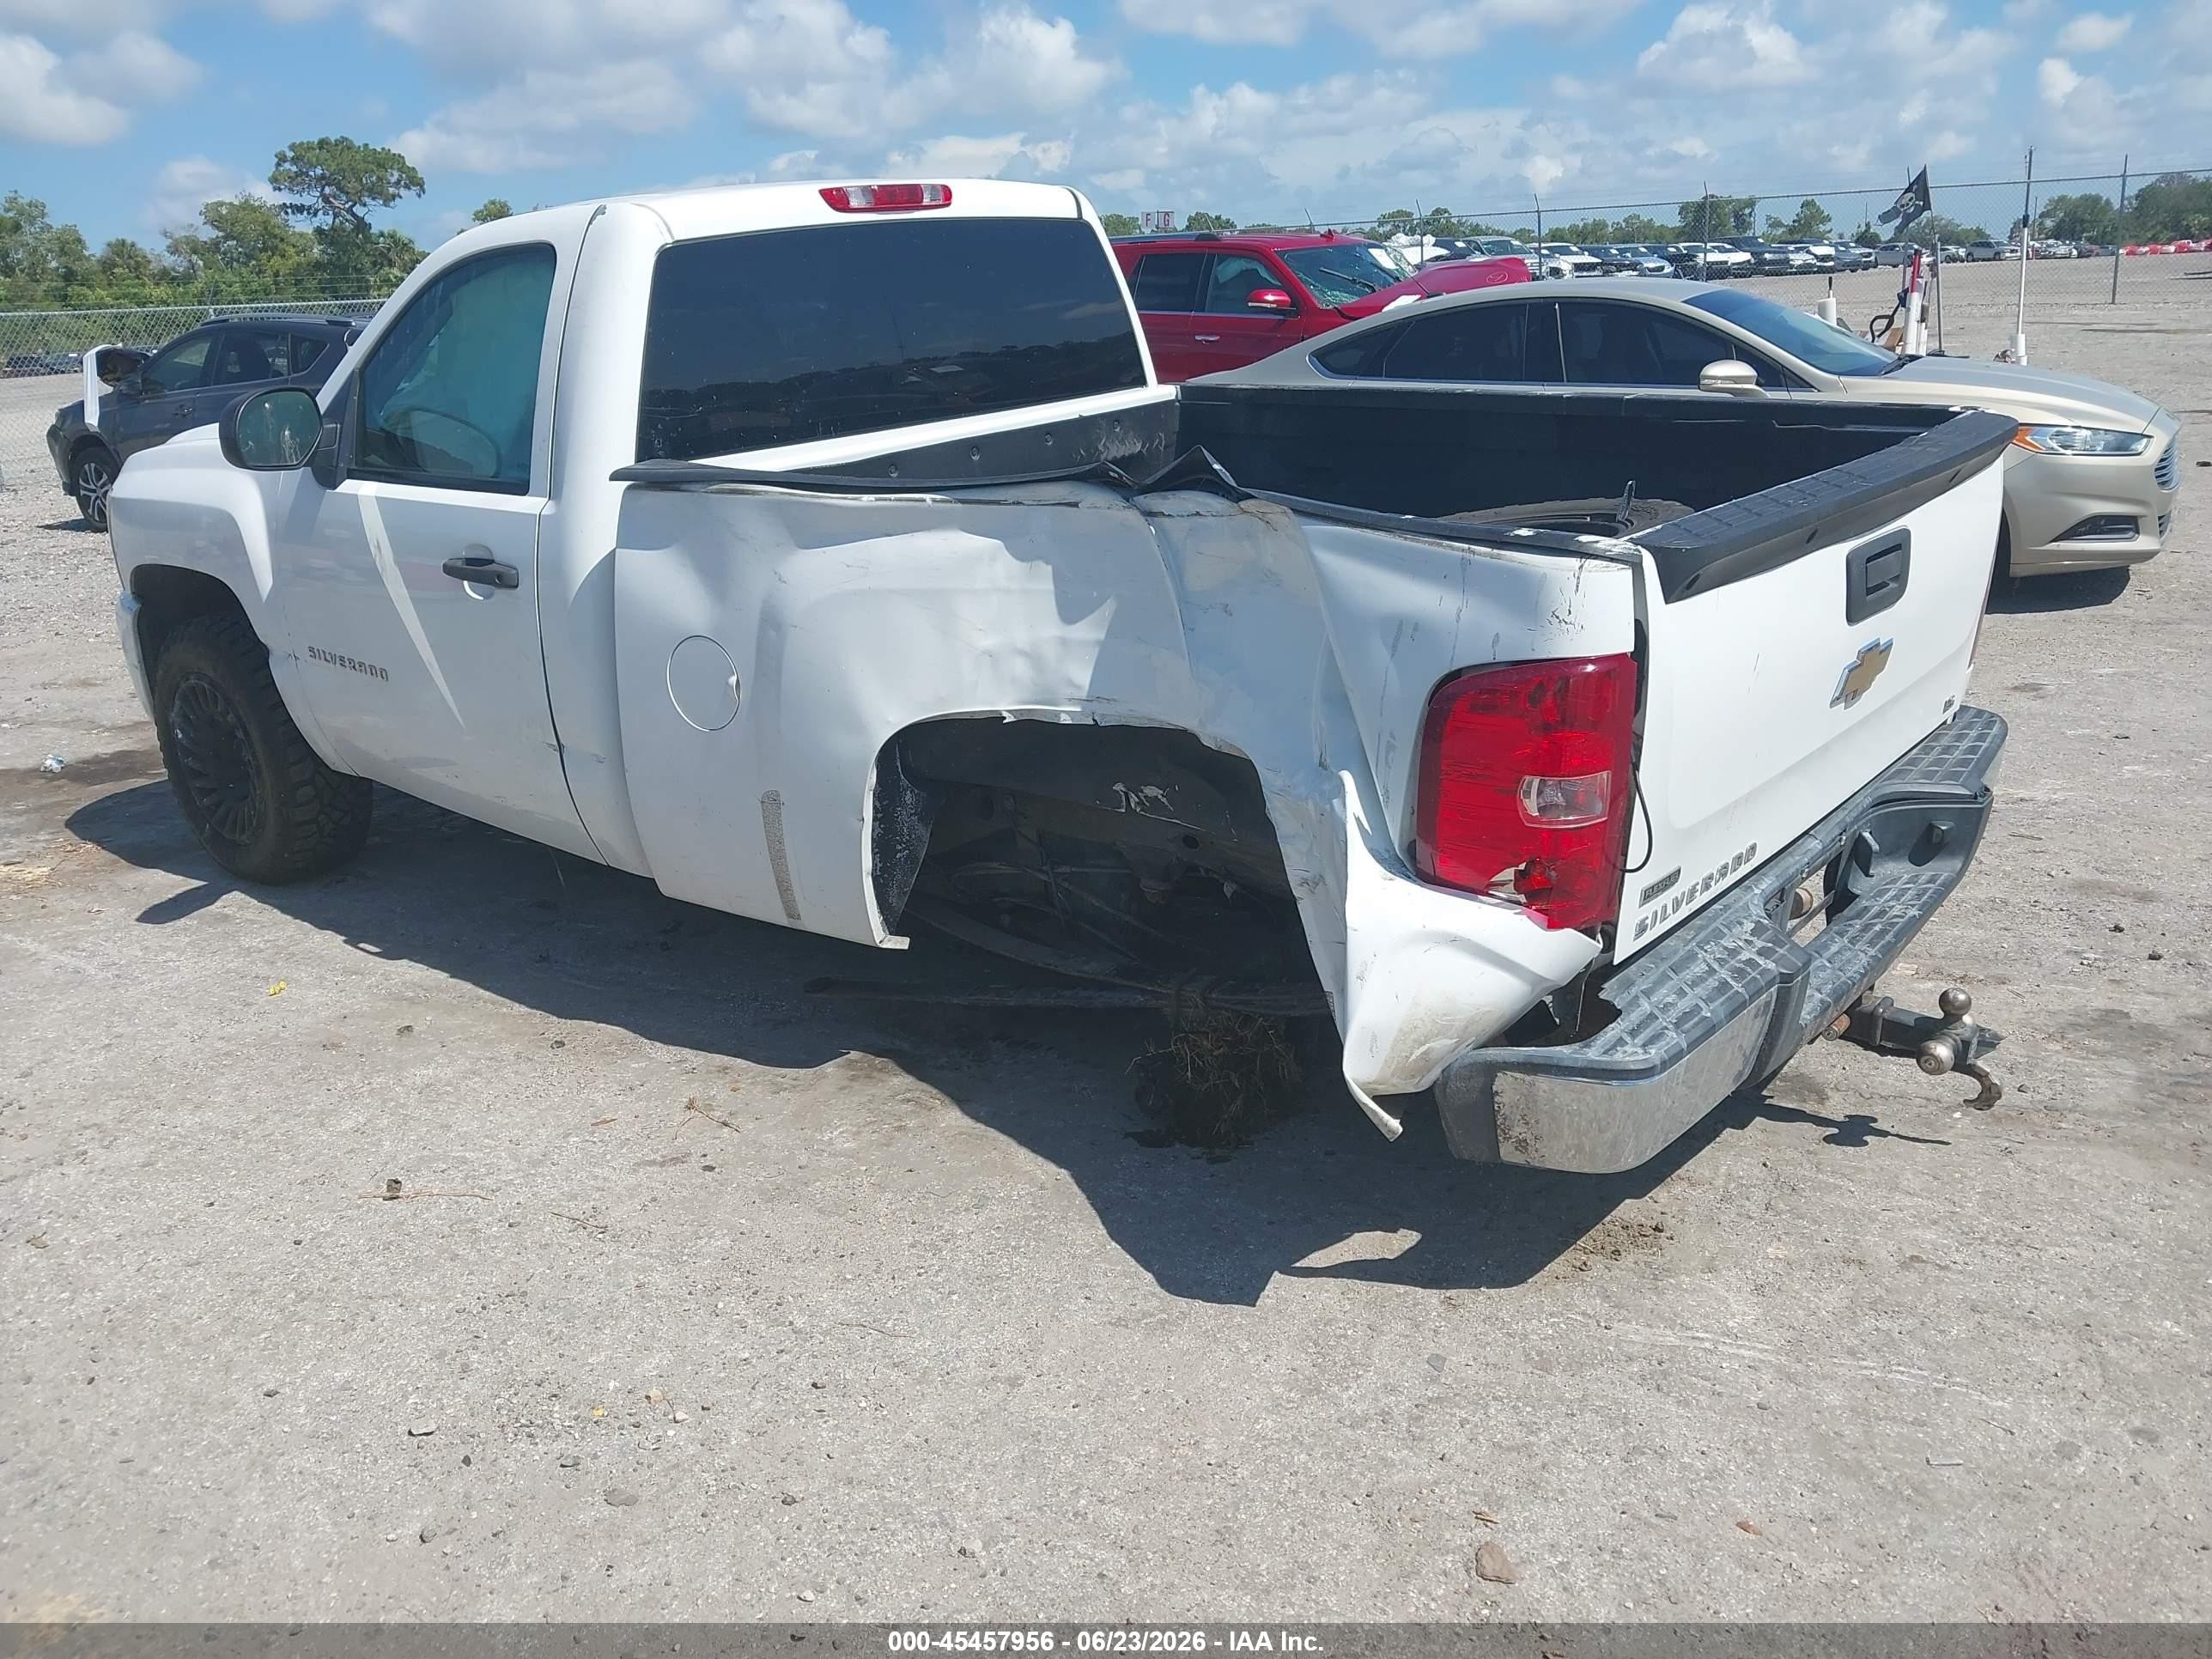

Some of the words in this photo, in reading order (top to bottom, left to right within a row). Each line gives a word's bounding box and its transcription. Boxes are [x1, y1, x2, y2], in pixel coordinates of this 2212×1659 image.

[1146, 213, 1152, 228] F
[1163, 212, 1170, 228] G
[307, 646, 389, 682] SILVERADO
[1632, 842, 1758, 942] SILVERADO
